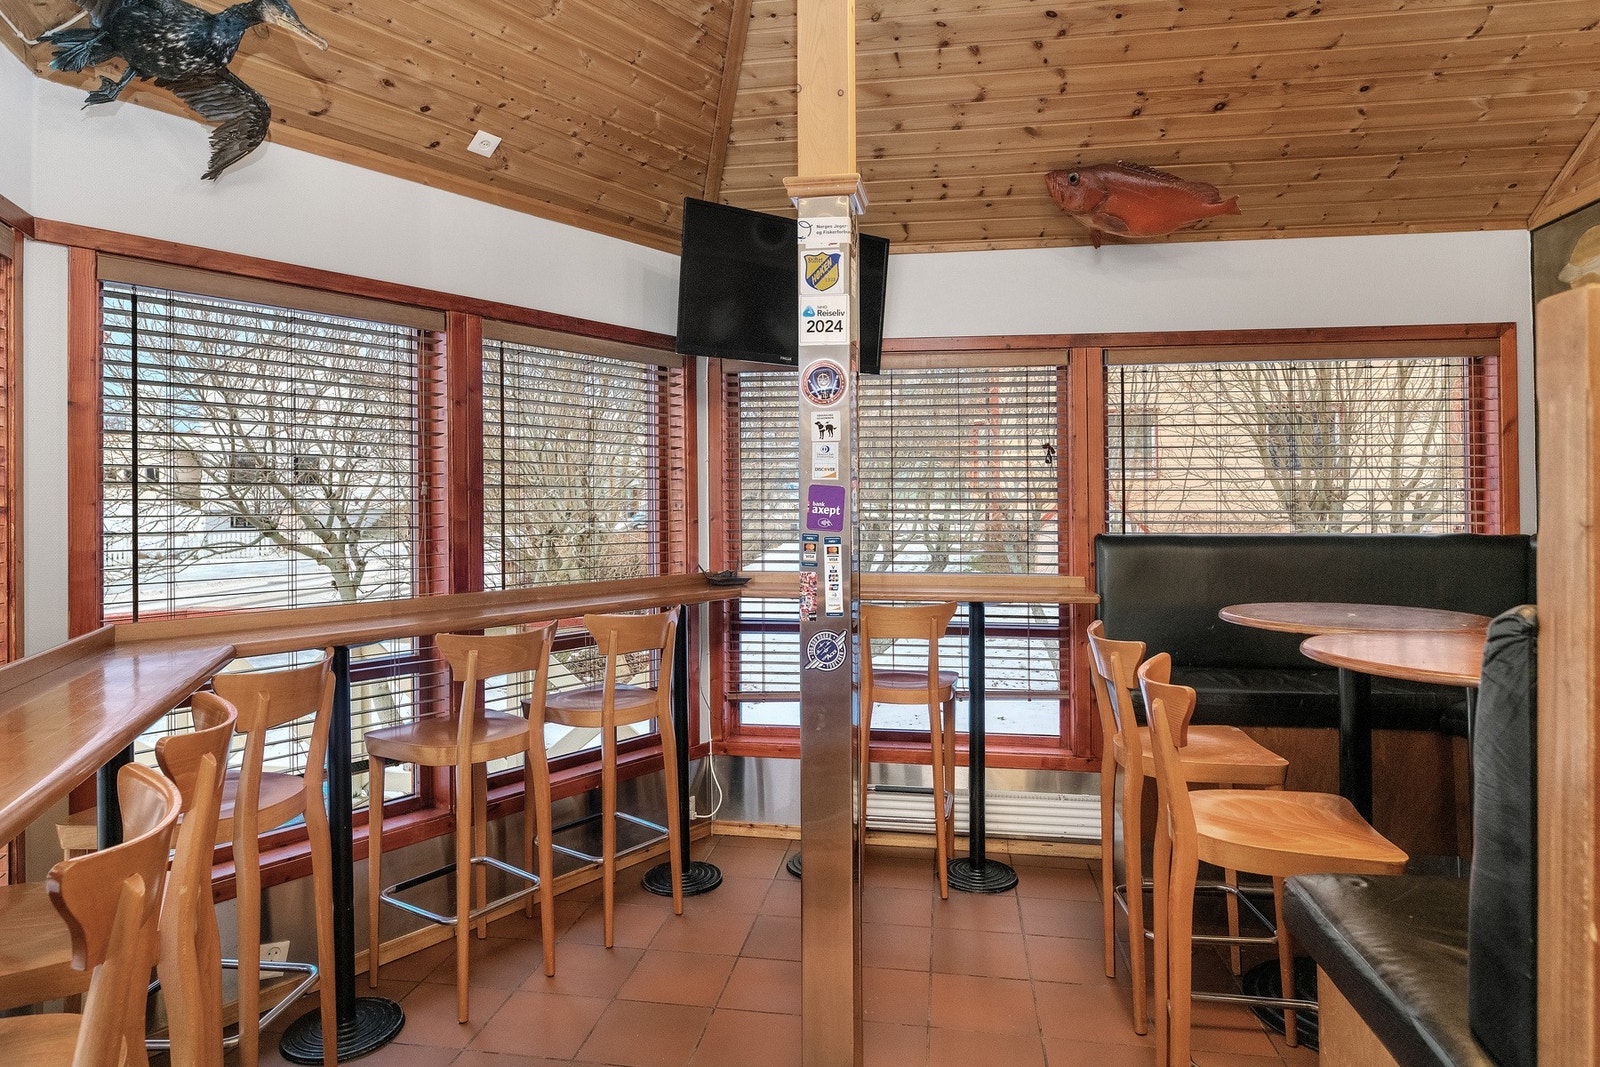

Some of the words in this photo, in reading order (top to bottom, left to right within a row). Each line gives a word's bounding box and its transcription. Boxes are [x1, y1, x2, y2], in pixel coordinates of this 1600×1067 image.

[817, 309, 845, 317] Reiseliv
[806, 320, 843, 332] 2024
[812, 506, 840, 517] axept
